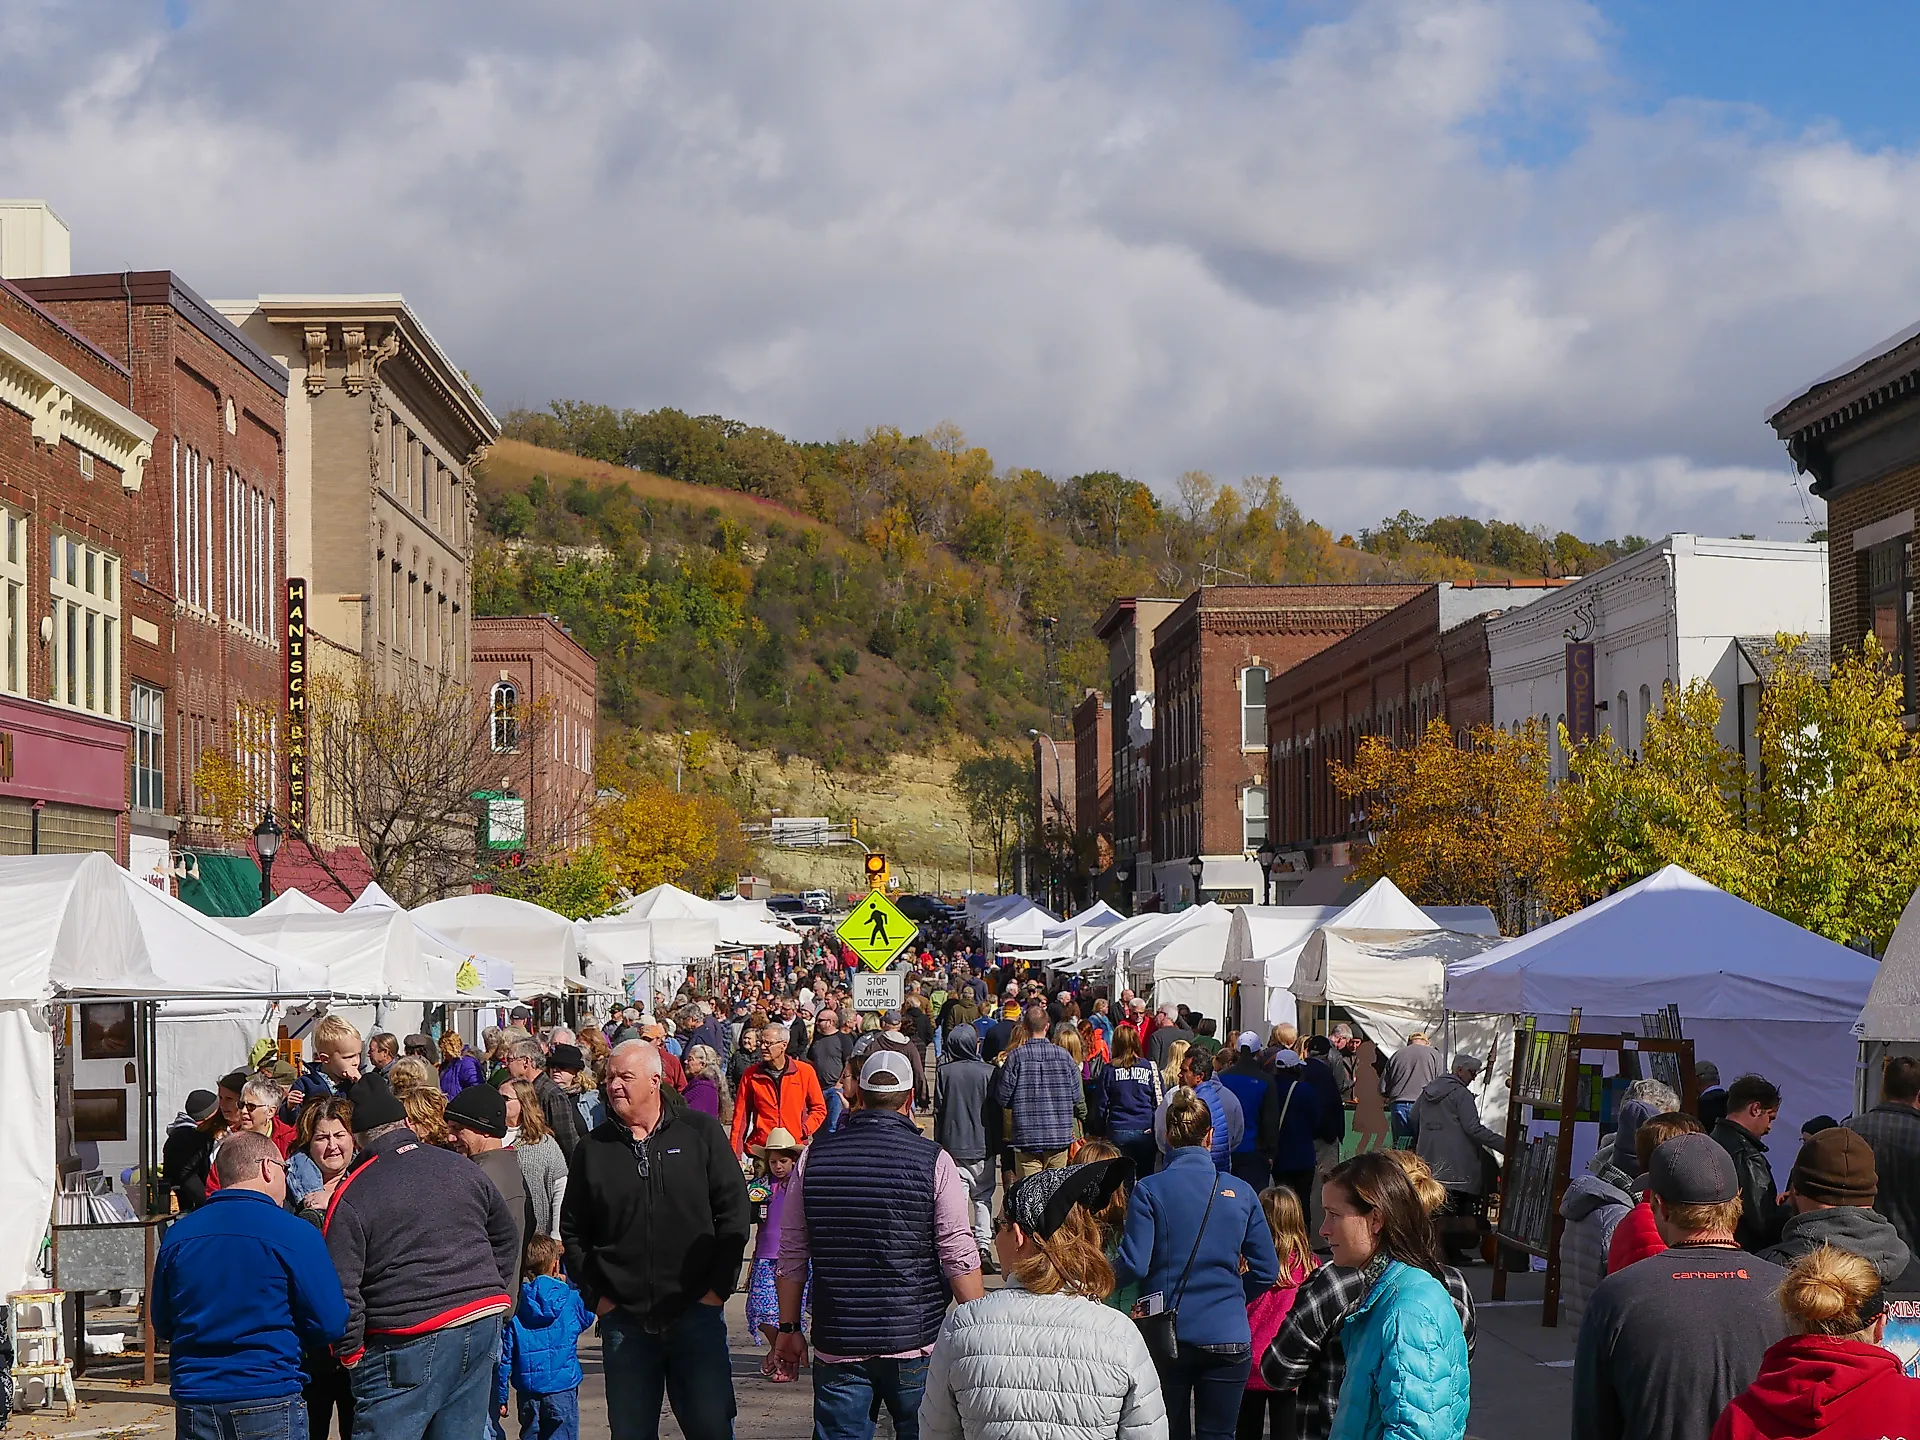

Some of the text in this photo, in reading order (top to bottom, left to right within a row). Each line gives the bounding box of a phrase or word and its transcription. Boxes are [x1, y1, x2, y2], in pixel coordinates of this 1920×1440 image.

[1573, 649, 1589, 740] COFF
[288, 585, 304, 830] HANISCH BAKERY
[867, 977, 888, 986] STOP
[865, 988, 889, 997] WHEN
[857, 998, 897, 1008] OCCUPIED
[1114, 1066, 1152, 1081] FIRE MEDIC
[1672, 1270, 1736, 1279] carhartt
